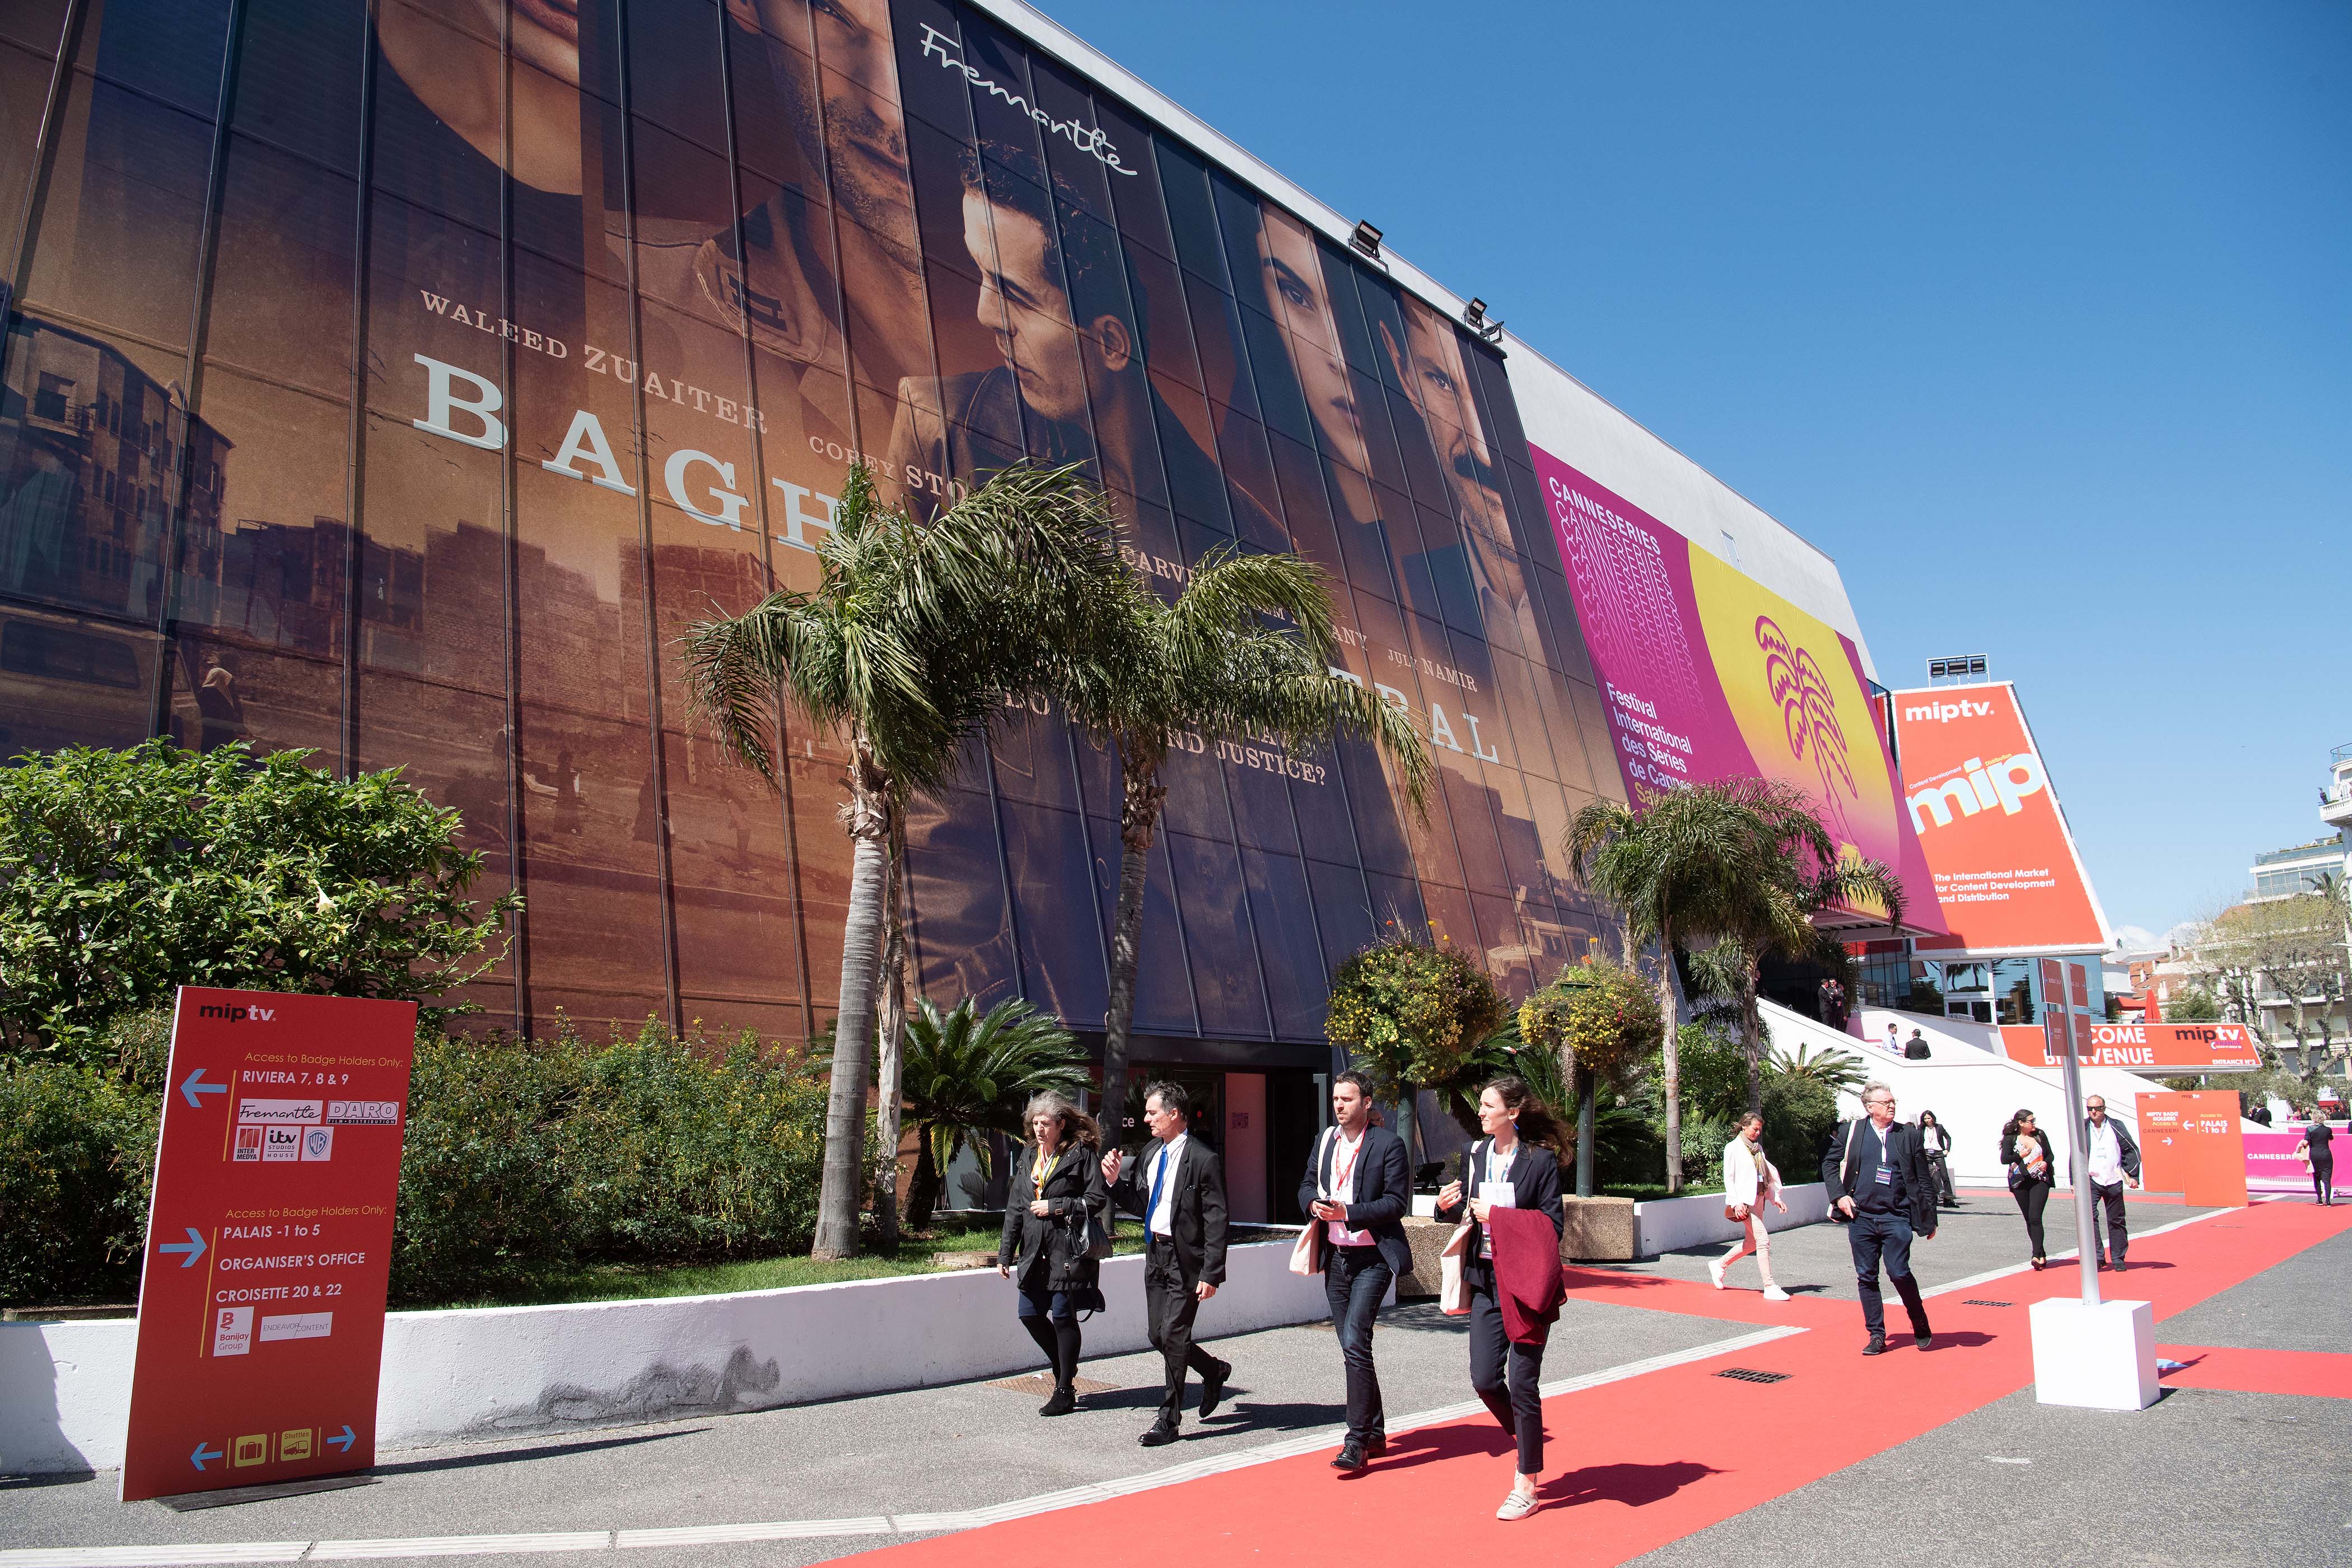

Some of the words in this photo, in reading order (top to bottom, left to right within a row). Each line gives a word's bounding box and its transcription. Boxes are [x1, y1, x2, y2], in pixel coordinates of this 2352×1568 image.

[920, 22, 1138, 175] Fremantle
[421, 290, 567, 359] WALEED
[585, 344, 768, 434] ZUAITER
[1549, 477, 1661, 555] CANNESERIES
[1388, 649, 1418, 671] JULY
[1421, 657, 1478, 693] NAMIR
[1606, 681, 1658, 720] Festival
[1905, 700, 1990, 722] miptv
[1613, 706, 1693, 754] International
[1622, 732, 1646, 758] des
[1647, 741, 1687, 773] Séries
[1216, 739, 1326, 786] JUSTICE?
[1629, 758, 1646, 780] de
[1908, 777, 1929, 790] Content
[1928, 766, 1962, 782] Development
[1984, 753, 2012, 767] Distribution
[1905, 753, 2045, 835] mip
[1934, 873, 1951, 882] The
[1953, 870, 2013, 881] International
[2014, 868, 2049, 878] Market
[1935, 884, 1948, 893] for
[1950, 882, 1988, 892] Content
[1990, 878, 2055, 890] Development
[1938, 894, 1955, 903] and
[1957, 892, 2009, 902] Distribution
[199, 1003, 273, 1023] miptv
[2175, 1026, 2240, 1043] miptv
[245, 1052, 283, 1063] Access
[287, 1053, 298, 1063] to
[301, 1054, 336, 1066] Badge
[339, 1056, 376, 1066] Holders
[378, 1057, 404, 1069] Only:
[242, 1070, 296, 1084] RIVIERA
[301, 1072, 311, 1085] 7,
[316, 1073, 324, 1085] 8
[328, 1074, 337, 1085] &
[342, 1074, 349, 1085] 9
[239, 1104, 321, 1119] Fremantle
[328, 1102, 398, 1119] DARO
[269, 1130, 297, 1144] itv
[226, 1208, 265, 1219] Access
[269, 1207, 280, 1218] to
[283, 1206, 318, 1219] Badge
[321, 1206, 359, 1216] Holders
[361, 1205, 387, 1217] Only:
[223, 1225, 272, 1239] PALAIS
[277, 1225, 290, 1238] -1
[295, 1225, 309, 1236] to
[311, 1224, 320, 1236] 5
[220, 1255, 314, 1271] ORGANISER'S
[318, 1253, 365, 1266] OFFICE
[216, 1286, 289, 1303] CROISETTE
[292, 1285, 309, 1298] 20
[312, 1285, 321, 1296] &
[326, 1284, 342, 1296] 22
[219, 1342, 243, 1351] Group
[220, 1333, 249, 1342] Banijay
[284, 1431, 310, 1440] Shuttles
